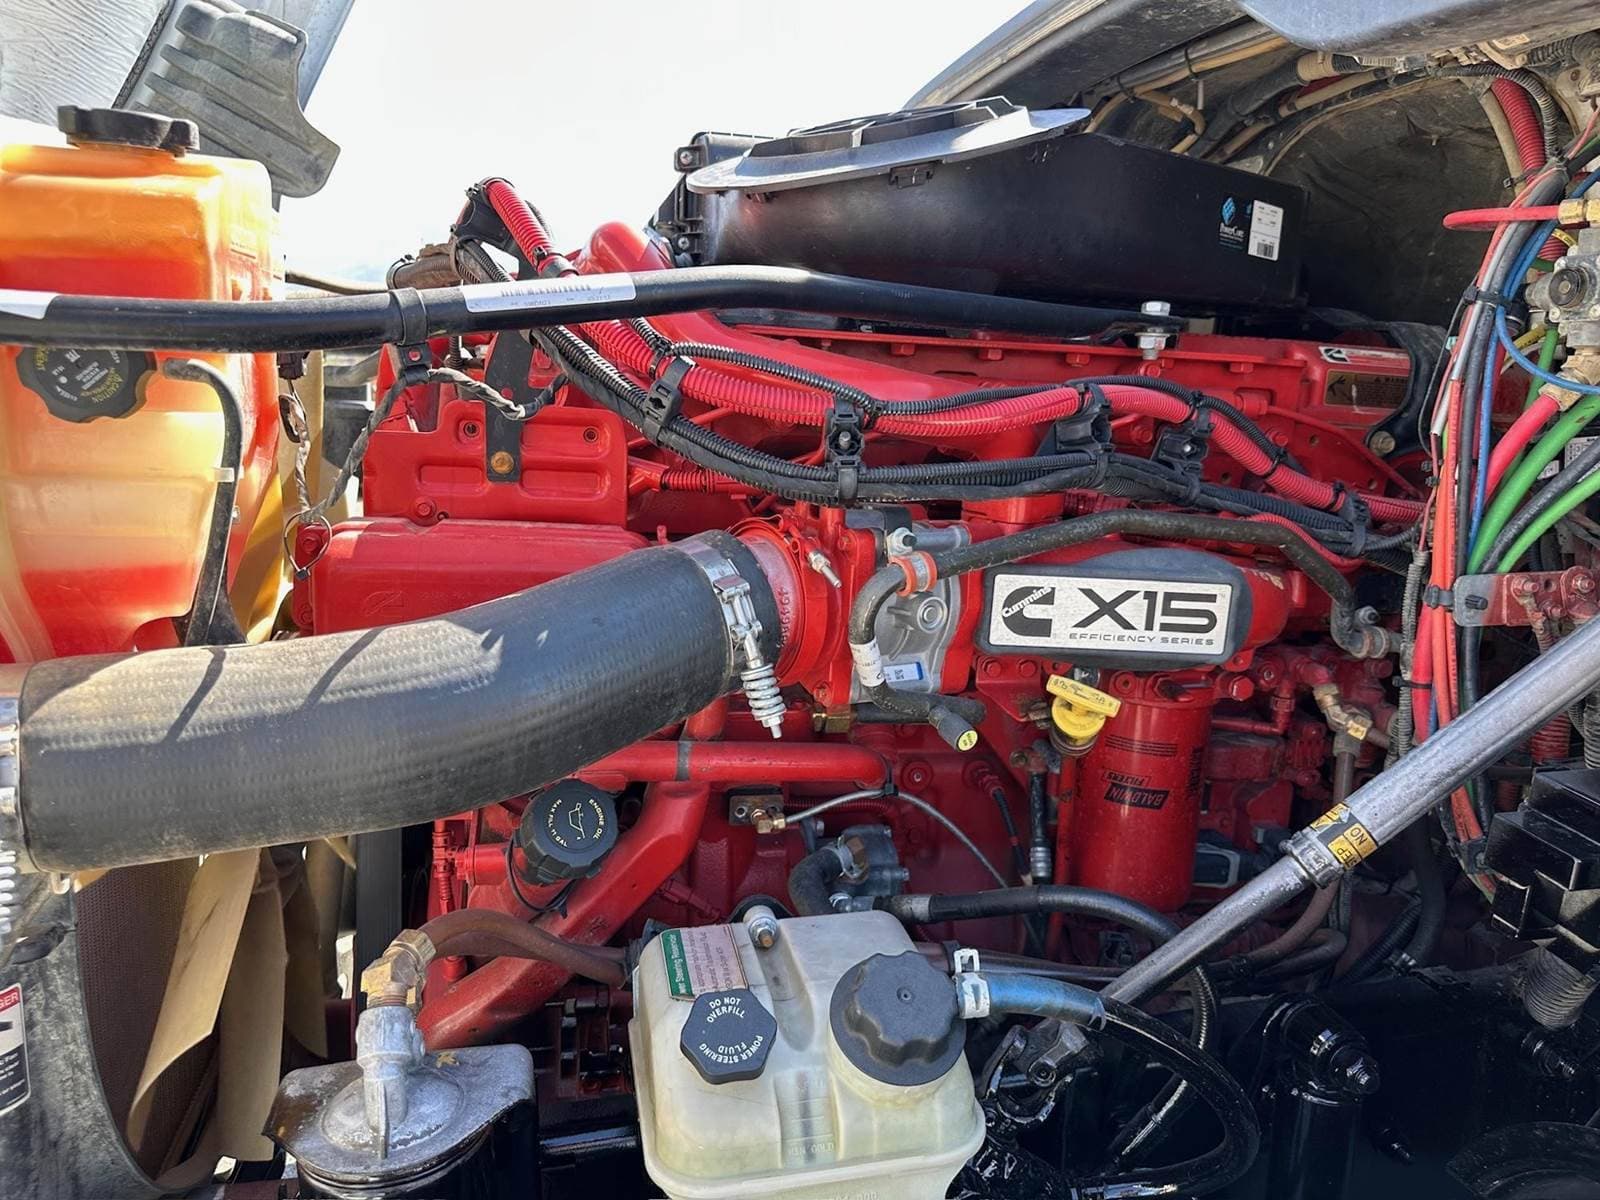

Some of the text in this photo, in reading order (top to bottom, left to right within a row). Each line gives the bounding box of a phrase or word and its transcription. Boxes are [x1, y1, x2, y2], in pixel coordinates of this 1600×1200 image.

[1002, 585, 1052, 618] Cummins
[1072, 587, 1218, 635] X15
[1069, 632, 1215, 646] EFFICIENCY SERIES
[1106, 771, 1146, 786] FILTERS
[1109, 786, 1165, 807] BALDWIN
[550, 799, 562, 813] MAX
[588, 799, 605, 840] ENGINE OIL
[555, 836, 568, 847] GAL
[672, 958, 686, 982] Steering
[709, 996, 741, 1009] DO NOT
[706, 1005, 746, 1023] OVERFILL
[699, 1035, 763, 1064] POWER STEERING
[717, 1041, 748, 1055] FLUID
